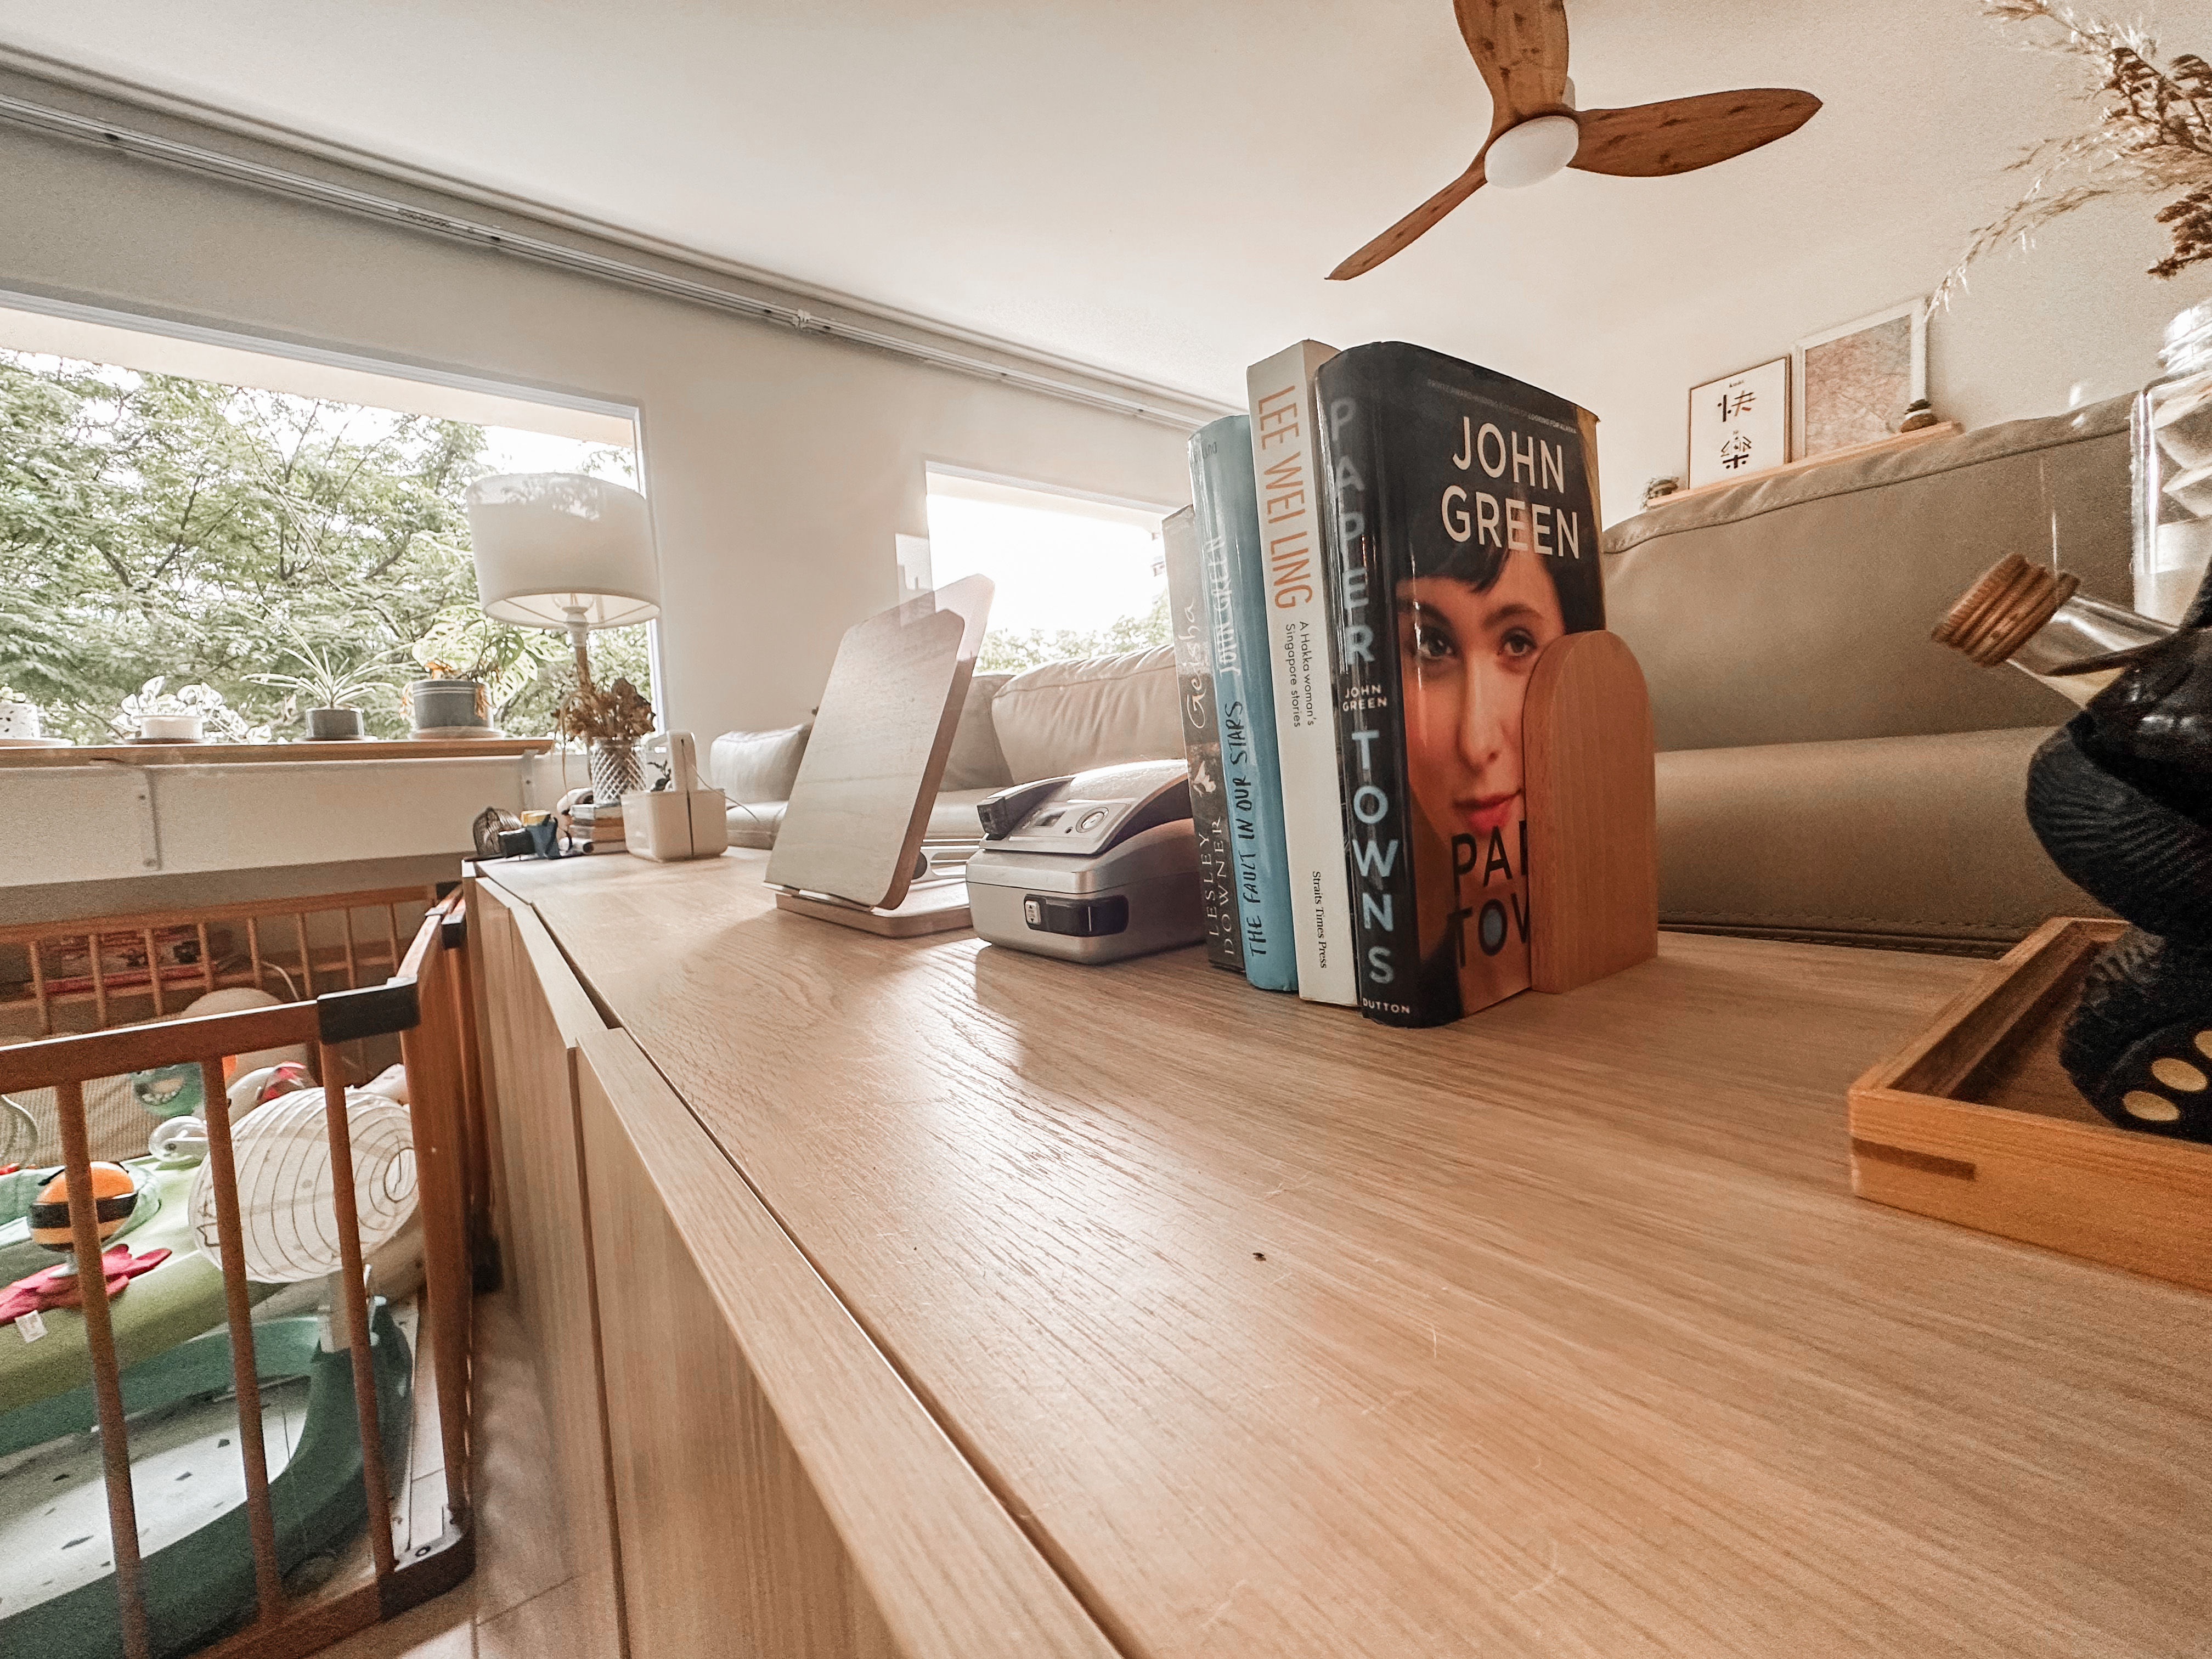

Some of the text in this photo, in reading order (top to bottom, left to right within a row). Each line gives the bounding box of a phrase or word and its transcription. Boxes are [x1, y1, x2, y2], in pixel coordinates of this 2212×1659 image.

[1258, 385, 1313, 609] LEE WEI LING
[1452, 416, 1564, 494] JOHN
[1330, 397, 1375, 665] PAPER
[1441, 485, 1579, 559] GREEN
[1178, 598, 1206, 729] Geisha
[1284, 623, 1302, 727] Singapore stories
[1300, 621, 1317, 726] A Hakka woman's
[1342, 696, 1387, 712] GREEN
[1345, 684, 1381, 698] JOHN
[1224, 701, 1266, 957] THE FAULT IN OUR STARS
[1352, 730, 1398, 984] TOWNS
[1198, 832, 1219, 936] LESLEY
[1212, 816, 1234, 955] DOWNER
[1313, 871, 1327, 969] Straits Times Press
[1363, 997, 1410, 1014] DUTTON
